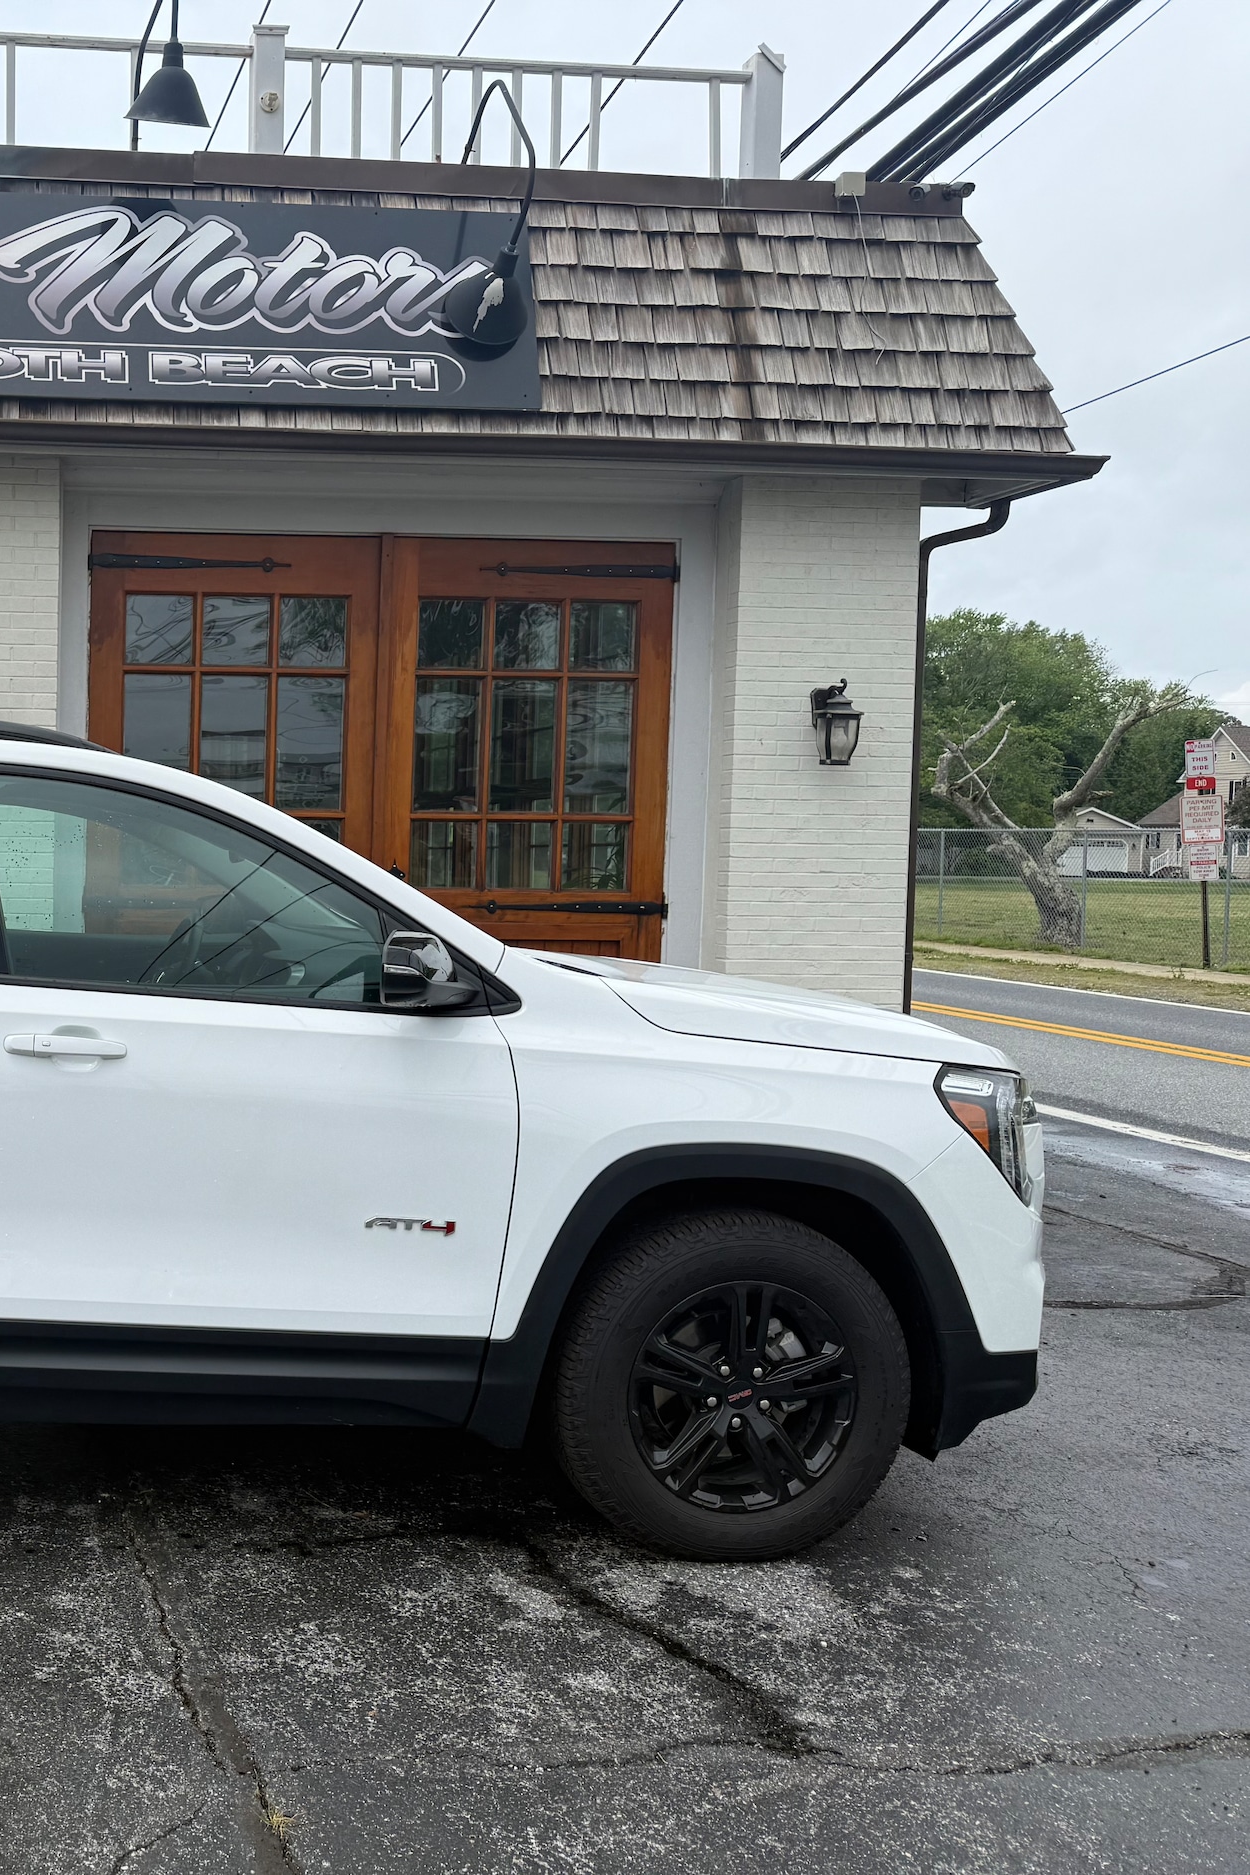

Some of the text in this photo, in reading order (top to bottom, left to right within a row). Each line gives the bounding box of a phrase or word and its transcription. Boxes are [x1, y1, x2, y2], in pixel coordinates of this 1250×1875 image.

[149, 351, 440, 391] BEACH
[1195, 779, 1207, 787] END
[365, 1216, 456, 1237] AT4
[728, 1388, 753, 1402] GMC
